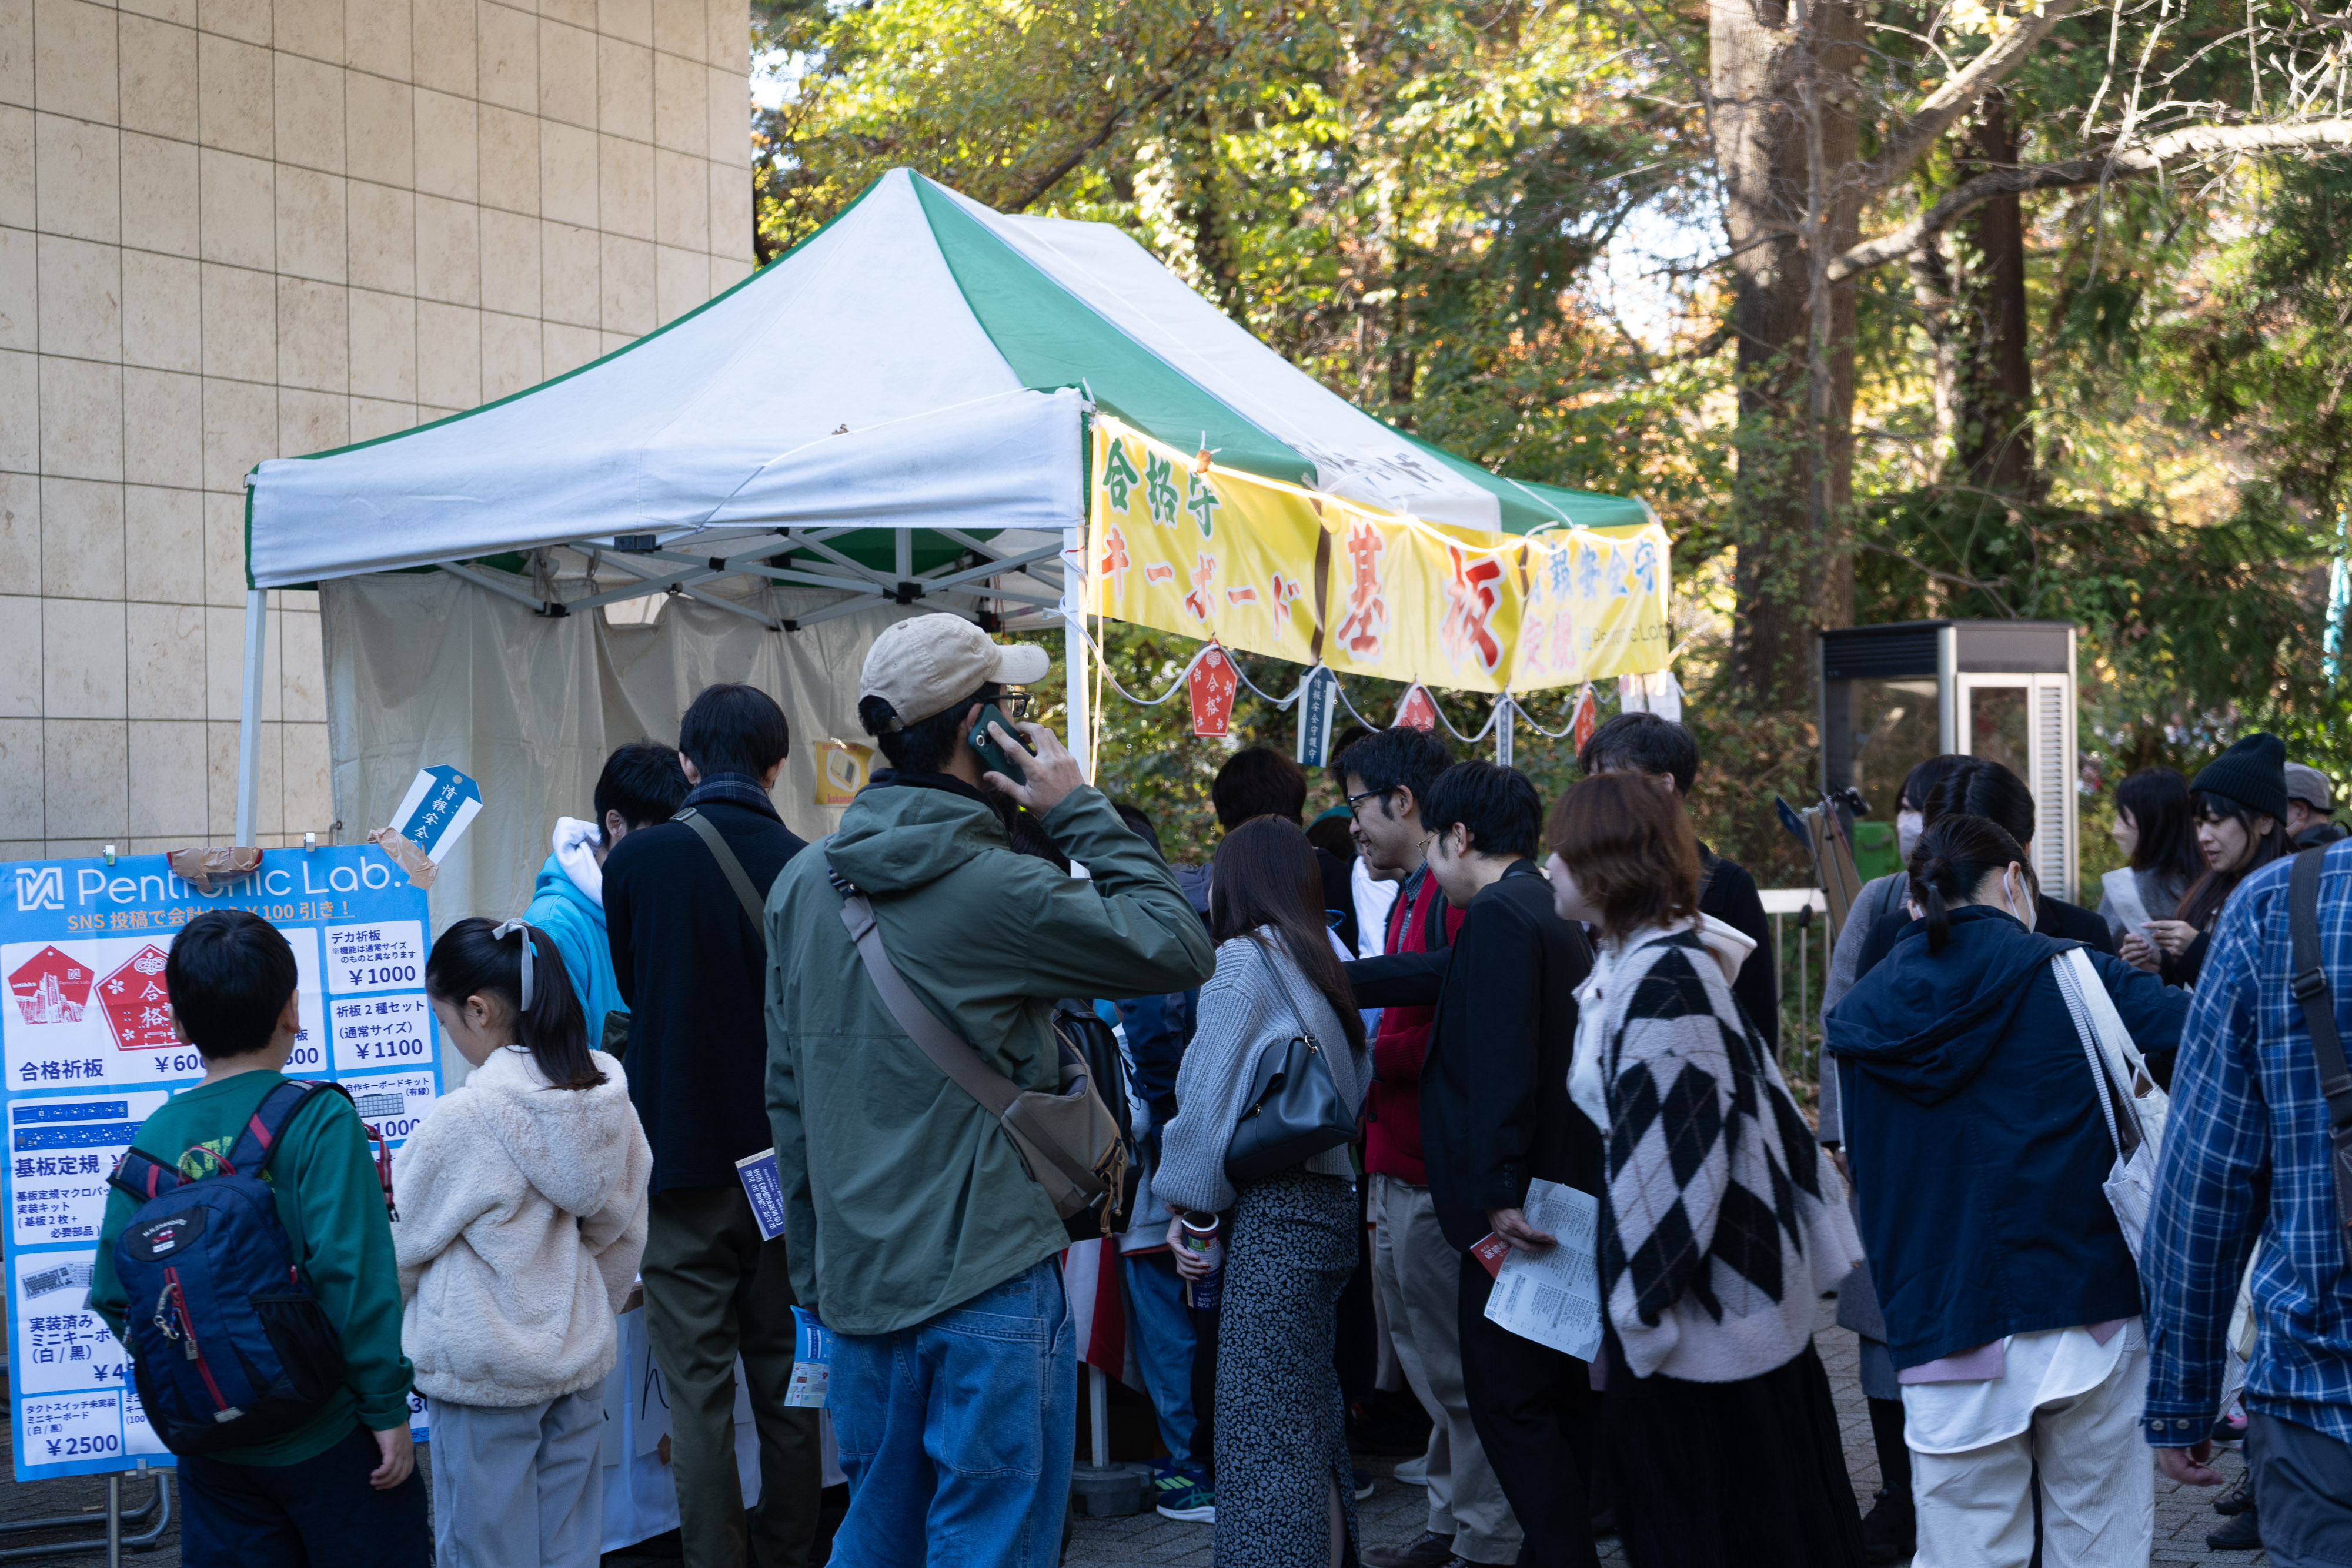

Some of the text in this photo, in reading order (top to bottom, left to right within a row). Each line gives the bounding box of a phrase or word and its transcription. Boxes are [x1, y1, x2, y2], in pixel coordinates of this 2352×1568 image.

[1338, 522, 1502, 668] 基板
[1205, 673, 1220, 717] 合格
[410, 784, 458, 843] 情報安全
[302, 856, 402, 895] Lab.
[331, 930, 382, 944] デカ祈板
[340, 951, 416, 964] のものと異なります
[19, 1058, 104, 1082] 合格祈板
[15, 1154, 100, 1178] 基板定規
[17, 1202, 70, 1215] 実装キット
[29, 1314, 93, 1332] 実装済み
[26, 1398, 117, 1414] タクトスイッチ未実装
[27, 1411, 89, 1424] ミニキーボード
